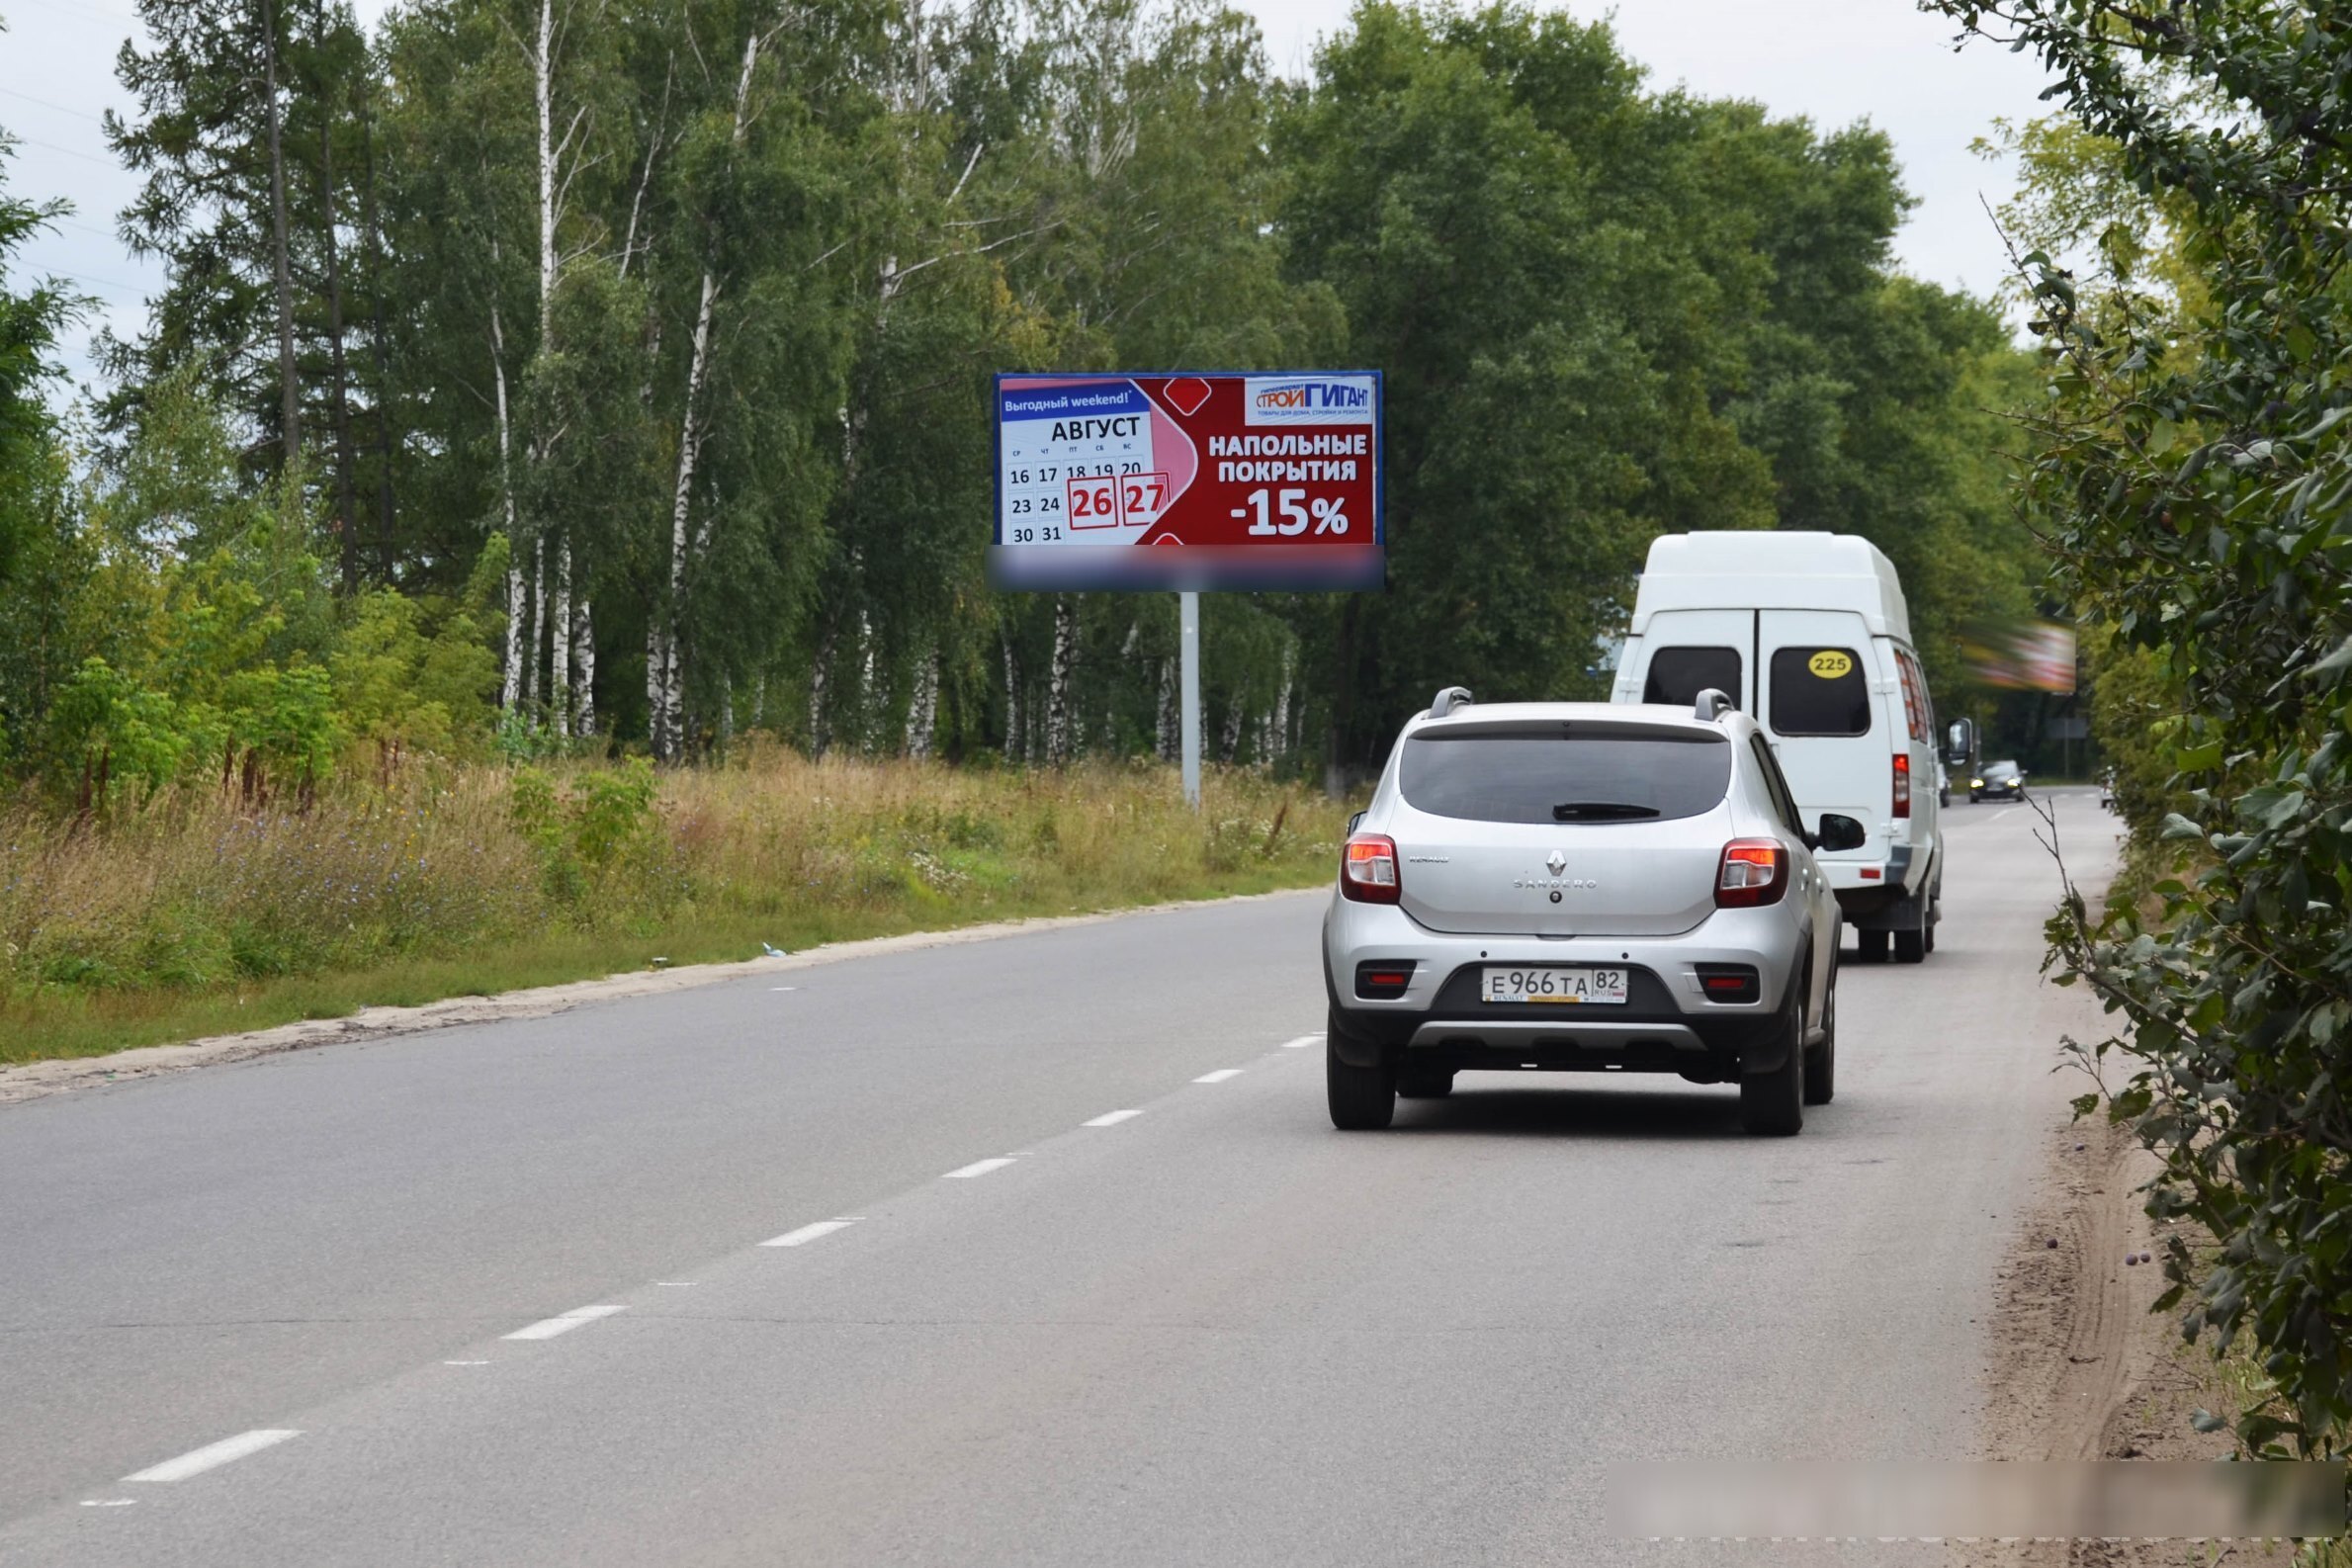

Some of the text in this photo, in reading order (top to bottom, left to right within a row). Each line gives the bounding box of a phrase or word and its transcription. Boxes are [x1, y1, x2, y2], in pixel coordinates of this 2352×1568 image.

[1004, 396, 1069, 412] Выгодный
[1051, 417, 1140, 442] АВГУСТ
[1209, 434, 1367, 457] НАПОЛЬНЫЕ
[1010, 462, 1141, 484] 16 17 18 19 20
[1218, 460, 1356, 482] ПОКРЫТИЯ
[1012, 483, 1165, 517] 23 24 26 27
[1230, 488, 1349, 536] -15%
[1013, 526, 1062, 543] 30 31
[1814, 657, 1847, 671] 225
[1513, 879, 1598, 889] SANDERO
[1596, 971, 1619, 989] 82
